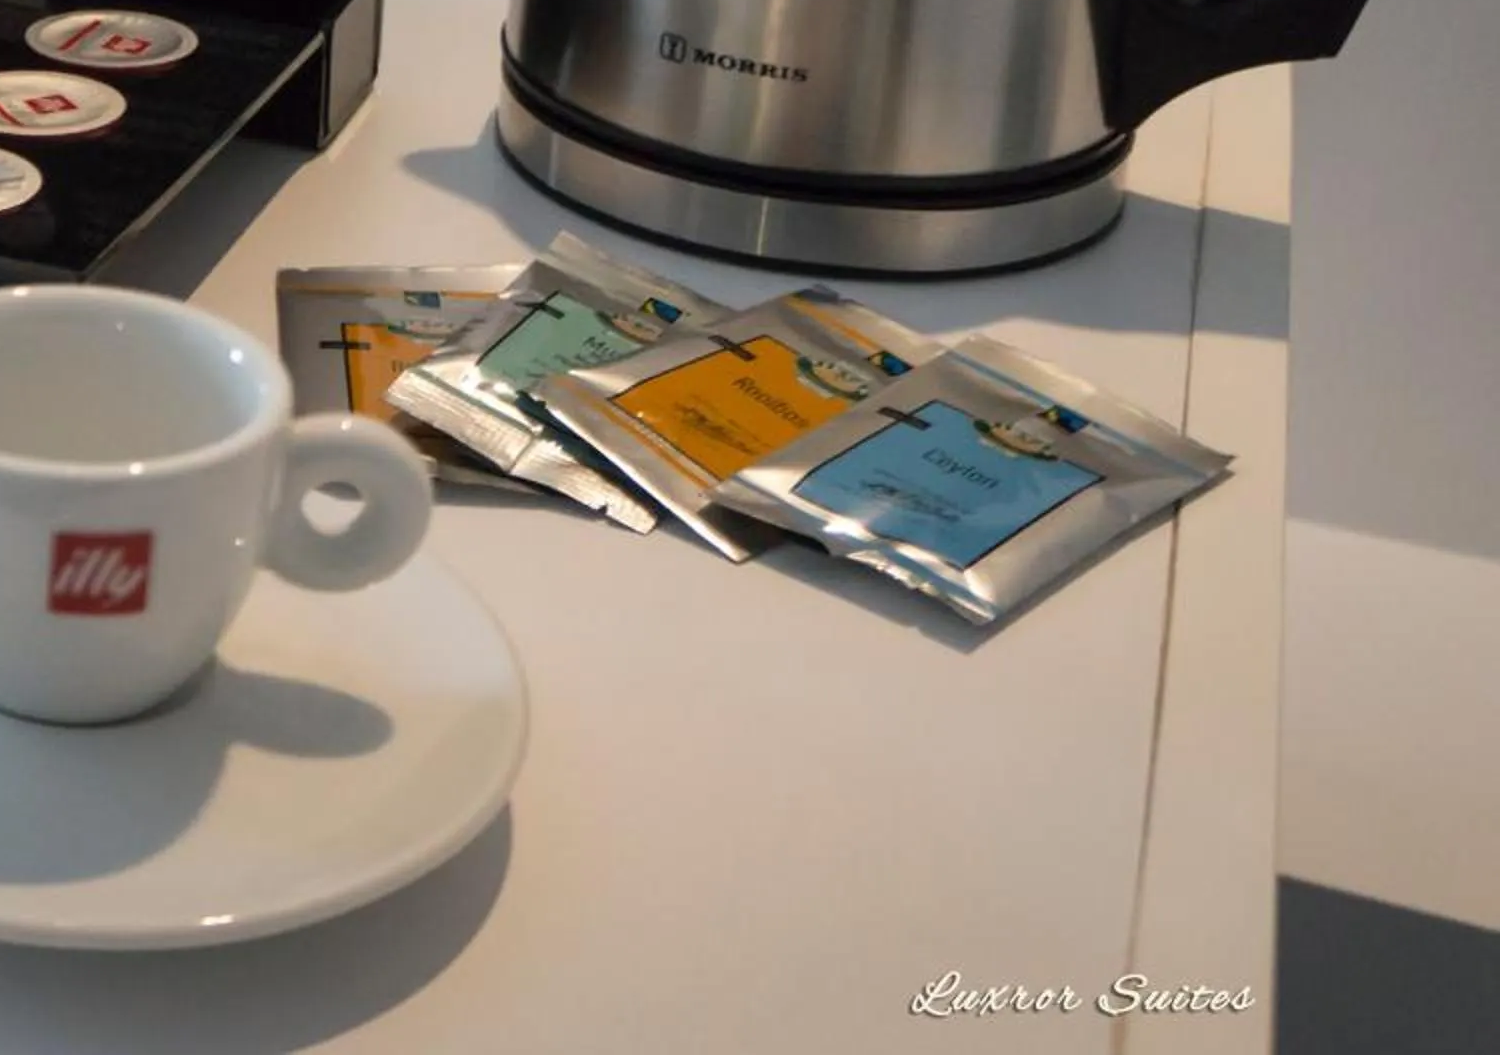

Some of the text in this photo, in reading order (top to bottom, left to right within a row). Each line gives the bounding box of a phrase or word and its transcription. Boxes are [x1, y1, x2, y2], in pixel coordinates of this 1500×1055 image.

[691, 47, 809, 83] MORRIS
[730, 375, 811, 429] Rooibos
[920, 447, 1000, 490] Ceylon
[52, 545, 145, 608] illy
